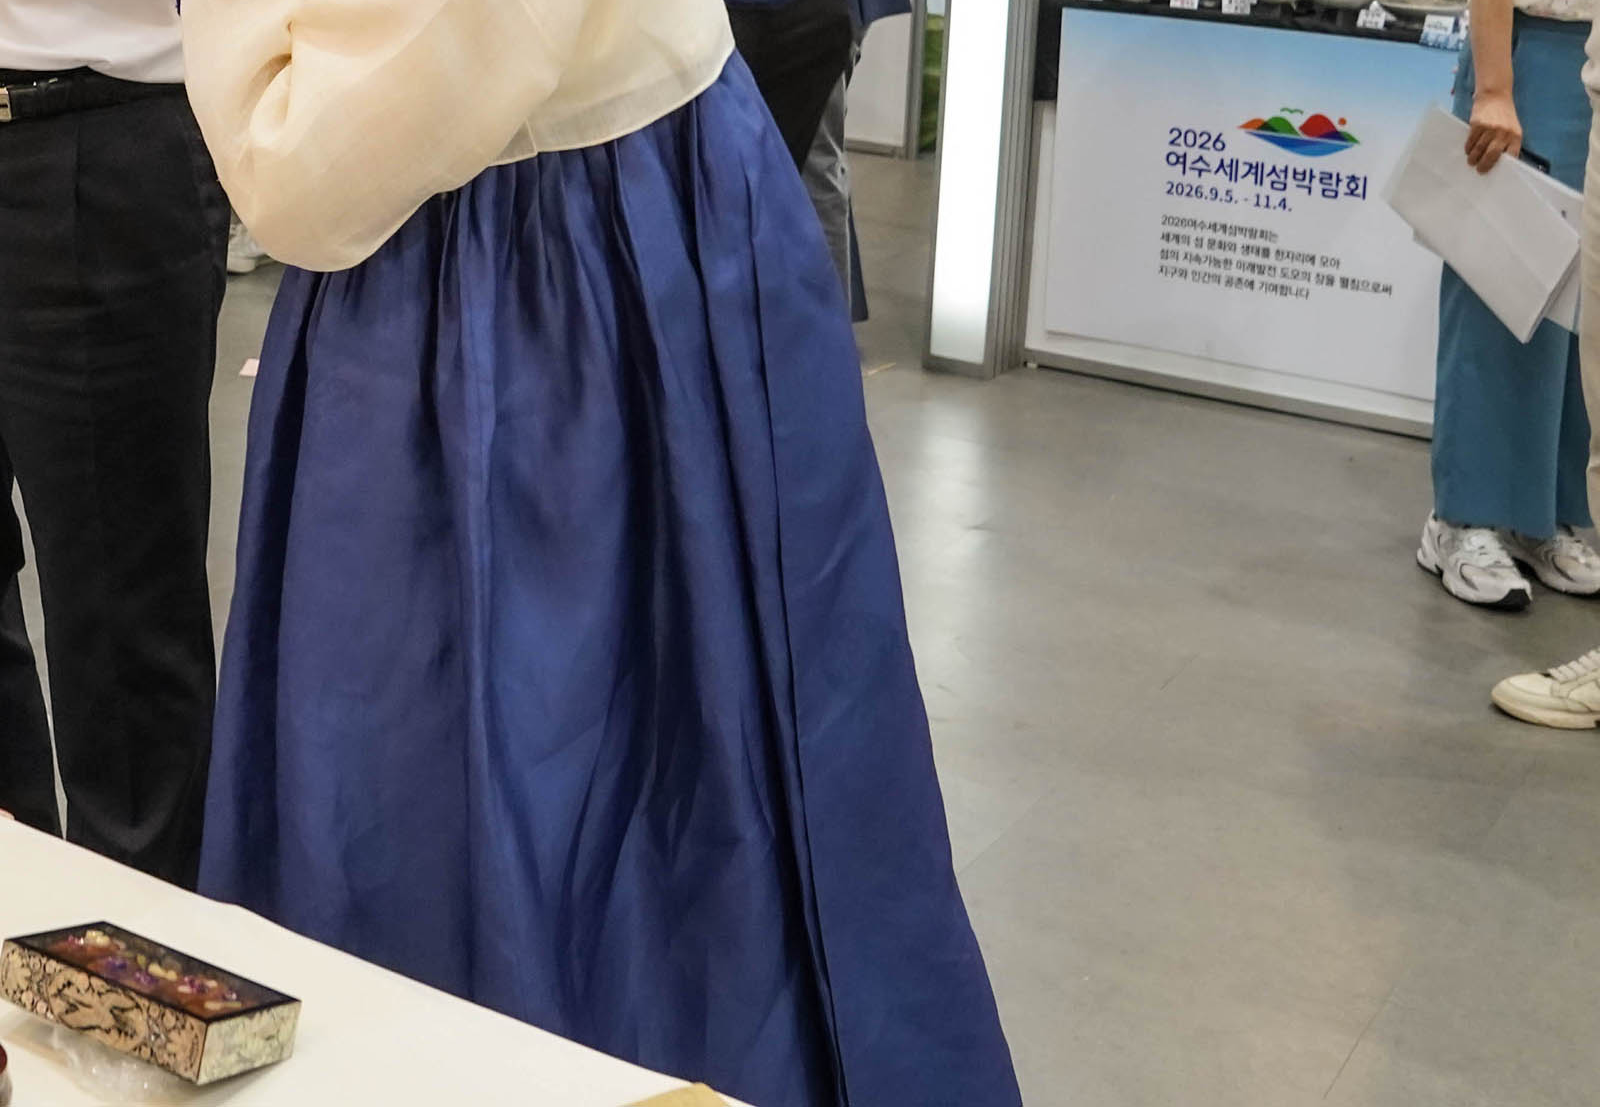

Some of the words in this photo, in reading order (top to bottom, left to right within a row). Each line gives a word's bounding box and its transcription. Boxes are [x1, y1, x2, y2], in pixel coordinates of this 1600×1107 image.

[1168, 127, 1226, 152] 2026
[1165, 151, 1368, 201] 여수세계섬박람회
[1165, 180, 1238, 205] 2026.9.5.
[1253, 193, 1293, 212] 11.4.
